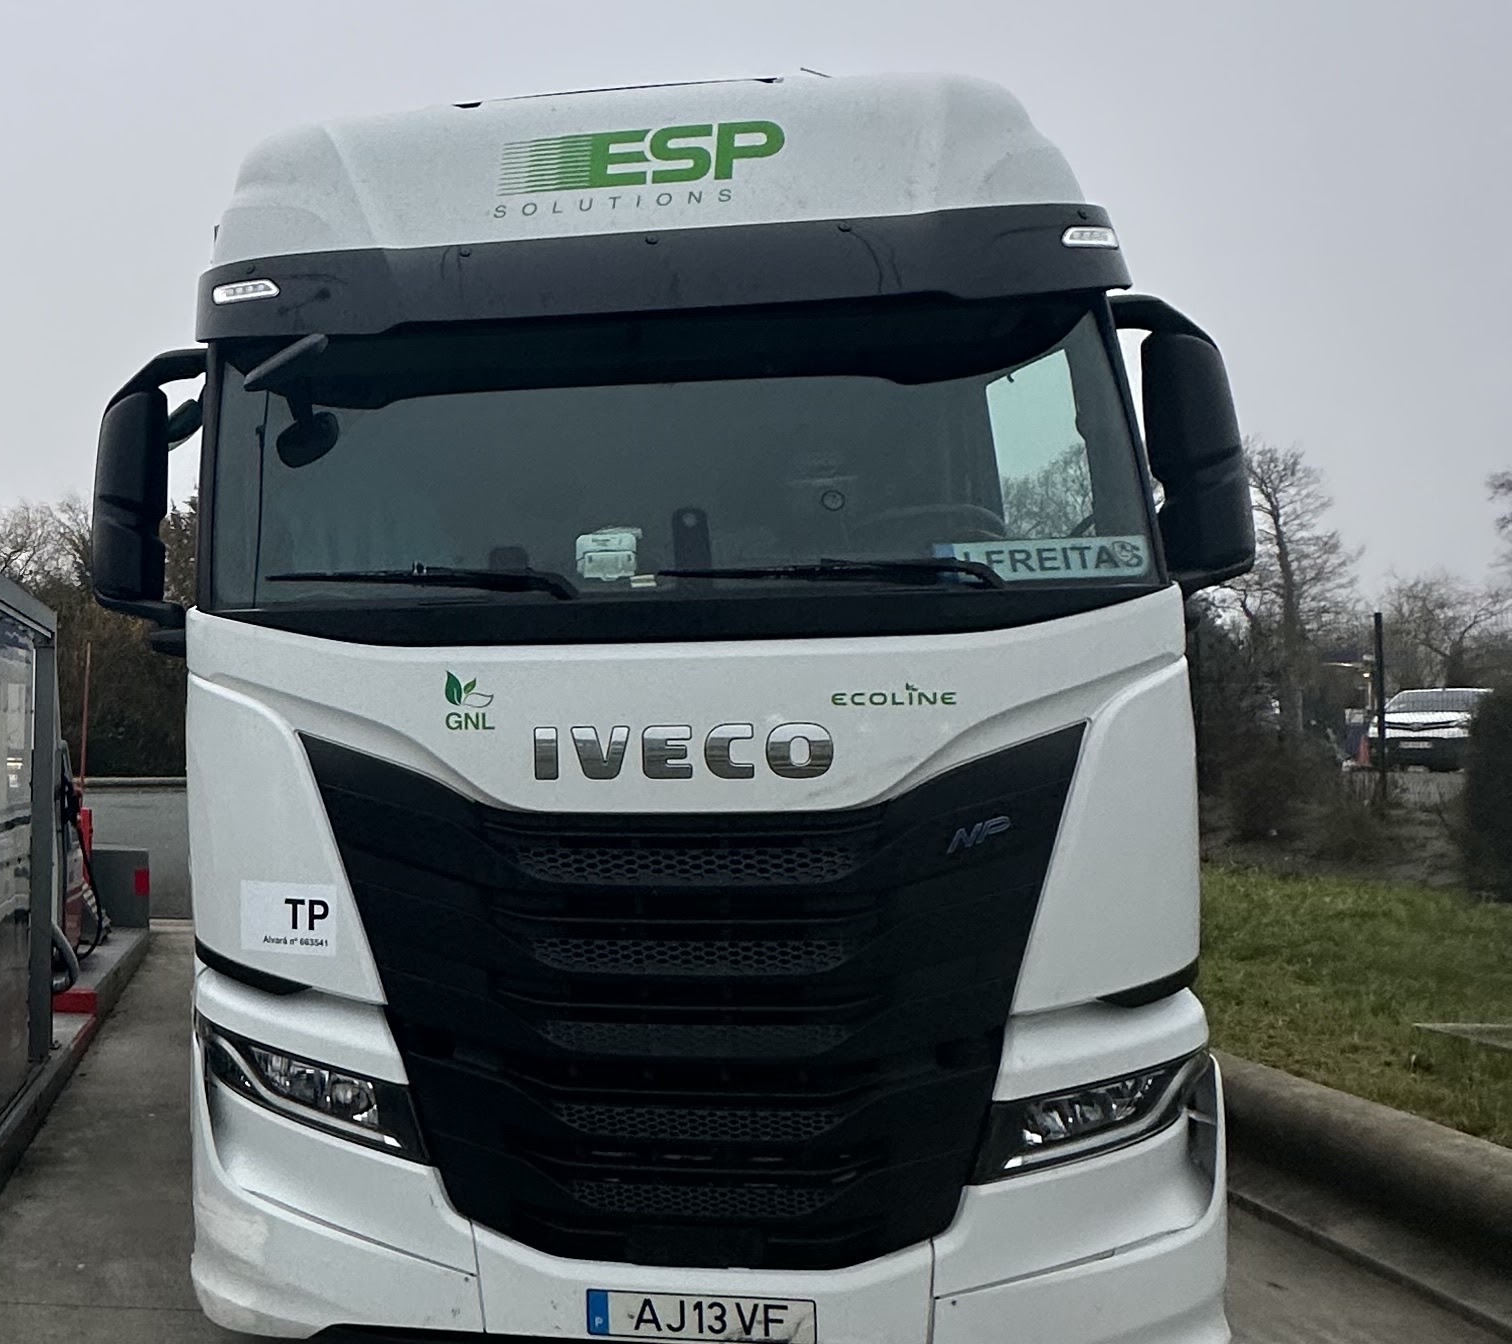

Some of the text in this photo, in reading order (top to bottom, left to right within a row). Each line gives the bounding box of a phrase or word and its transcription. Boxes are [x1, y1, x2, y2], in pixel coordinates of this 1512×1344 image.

[587, 120, 785, 189] ESP
[493, 188, 733, 219] SOLUTIONS
[985, 545, 1143, 572] FREITAS
[831, 686, 957, 706] ECOLINE
[445, 711, 495, 731] GNL
[533, 722, 834, 781] IVECO
[947, 815, 1011, 854] NP
[284, 898, 330, 931] TP
